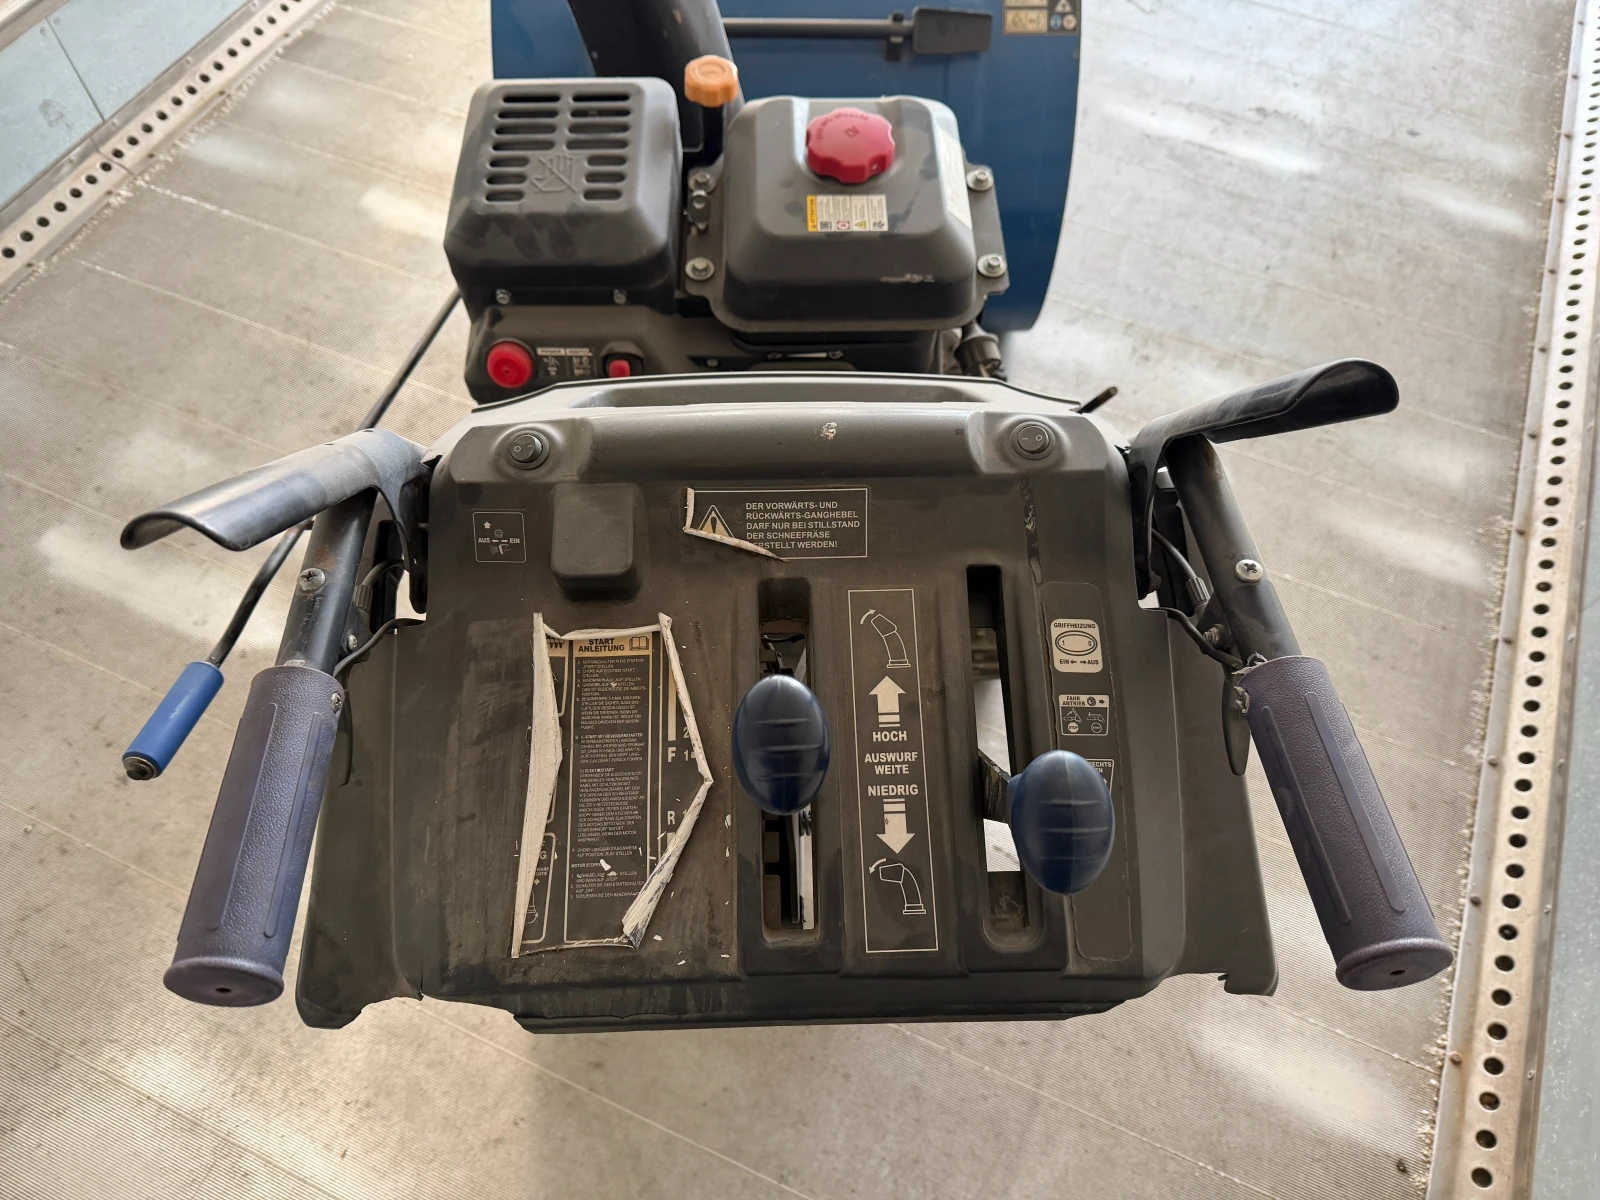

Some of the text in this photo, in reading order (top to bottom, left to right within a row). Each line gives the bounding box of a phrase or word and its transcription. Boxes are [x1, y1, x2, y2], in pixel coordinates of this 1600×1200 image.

[766, 500, 818, 510] VORWÄRTS-
[746, 511, 858, 520] RÜCKWÄRTS-GANGHEBEL
[808, 520, 860, 528] STILLSTAND
[766, 530, 830, 539] SCHNEEFRÄSE
[578, 644, 624, 652] ANLEITUNG
[683, 727, 690, 738] 2
[872, 730, 907, 742] HOCH
[668, 746, 689, 762] F 1
[864, 752, 918, 762] AUSWURF
[874, 764, 909, 774] WEITE
[868, 784, 918, 796] NIEDRIG
[668, 810, 675, 825] R
